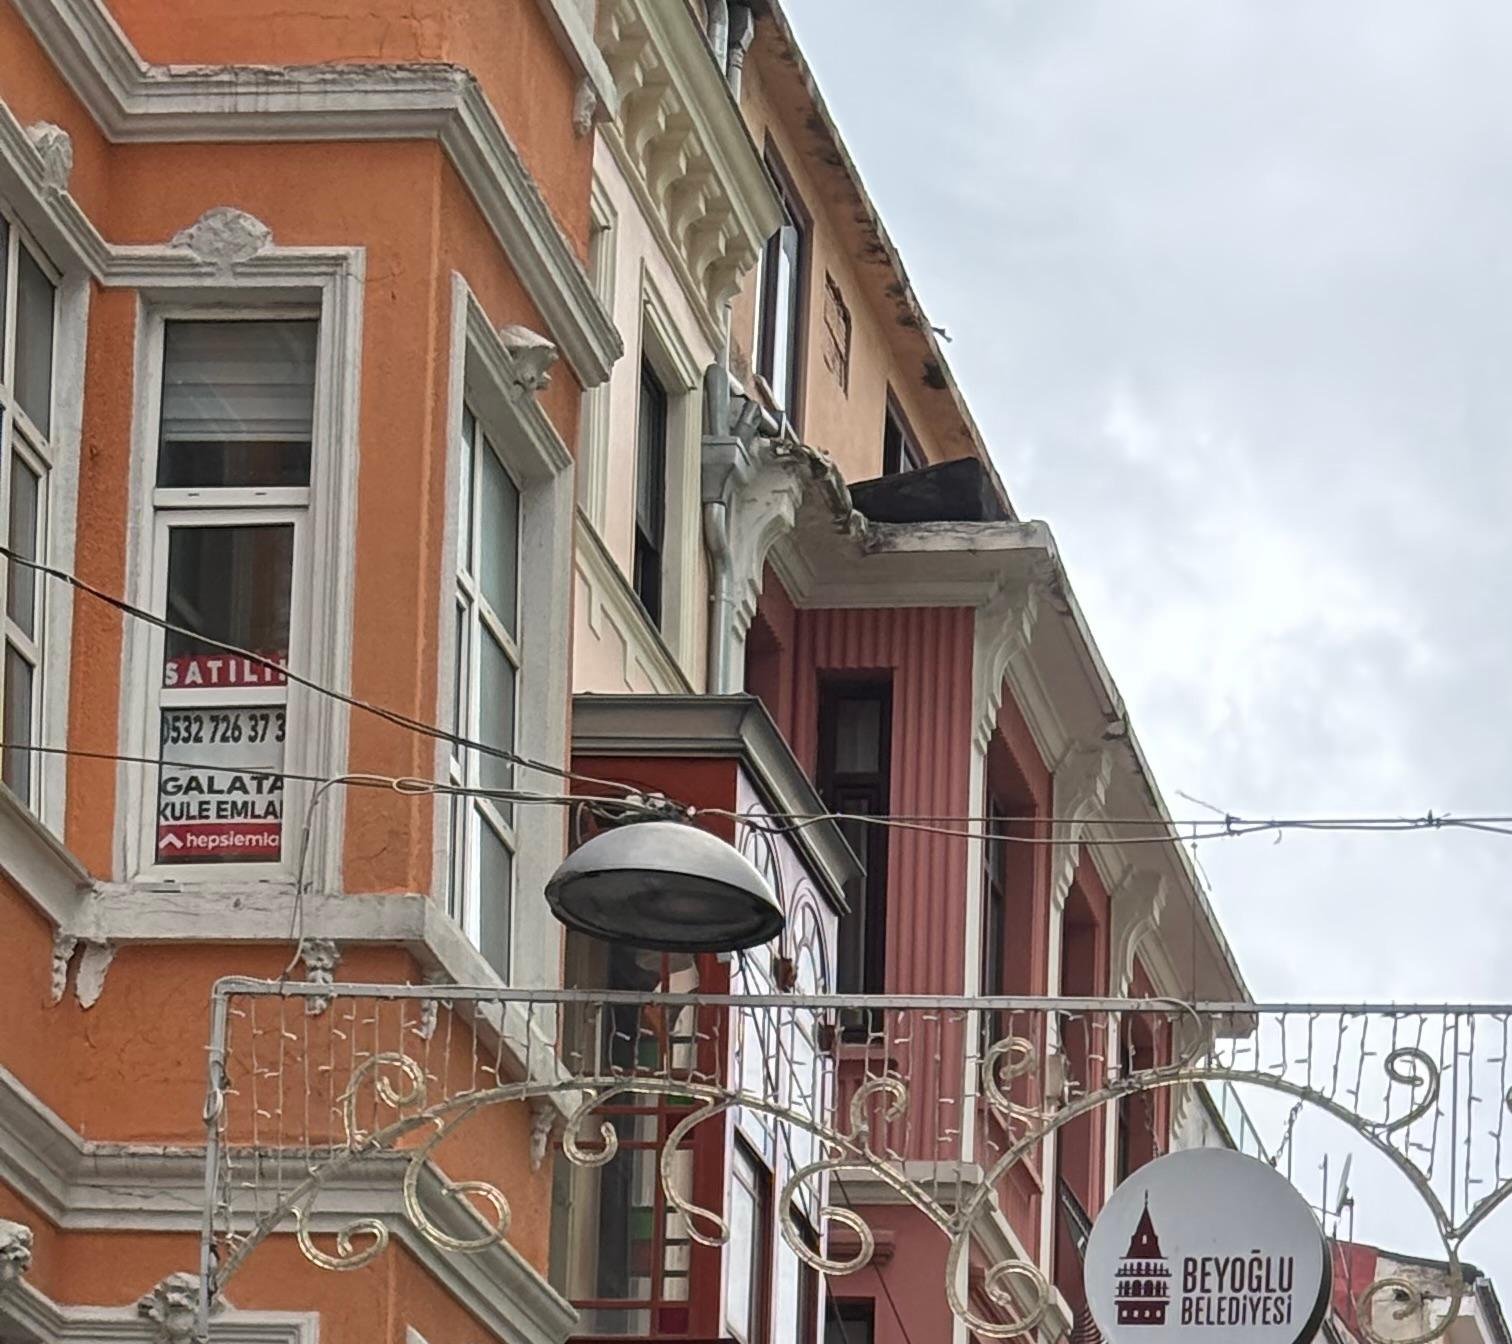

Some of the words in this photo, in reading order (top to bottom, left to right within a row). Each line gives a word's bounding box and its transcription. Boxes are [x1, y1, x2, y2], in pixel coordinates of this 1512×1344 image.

[209, 714, 242, 744] 726
[248, 713, 270, 743] 37
[161, 775, 284, 796] GALATA
[160, 800, 211, 821] KULE
[215, 799, 282, 820] EMLA
[1182, 1249, 1294, 1294] BEYOĞLU
